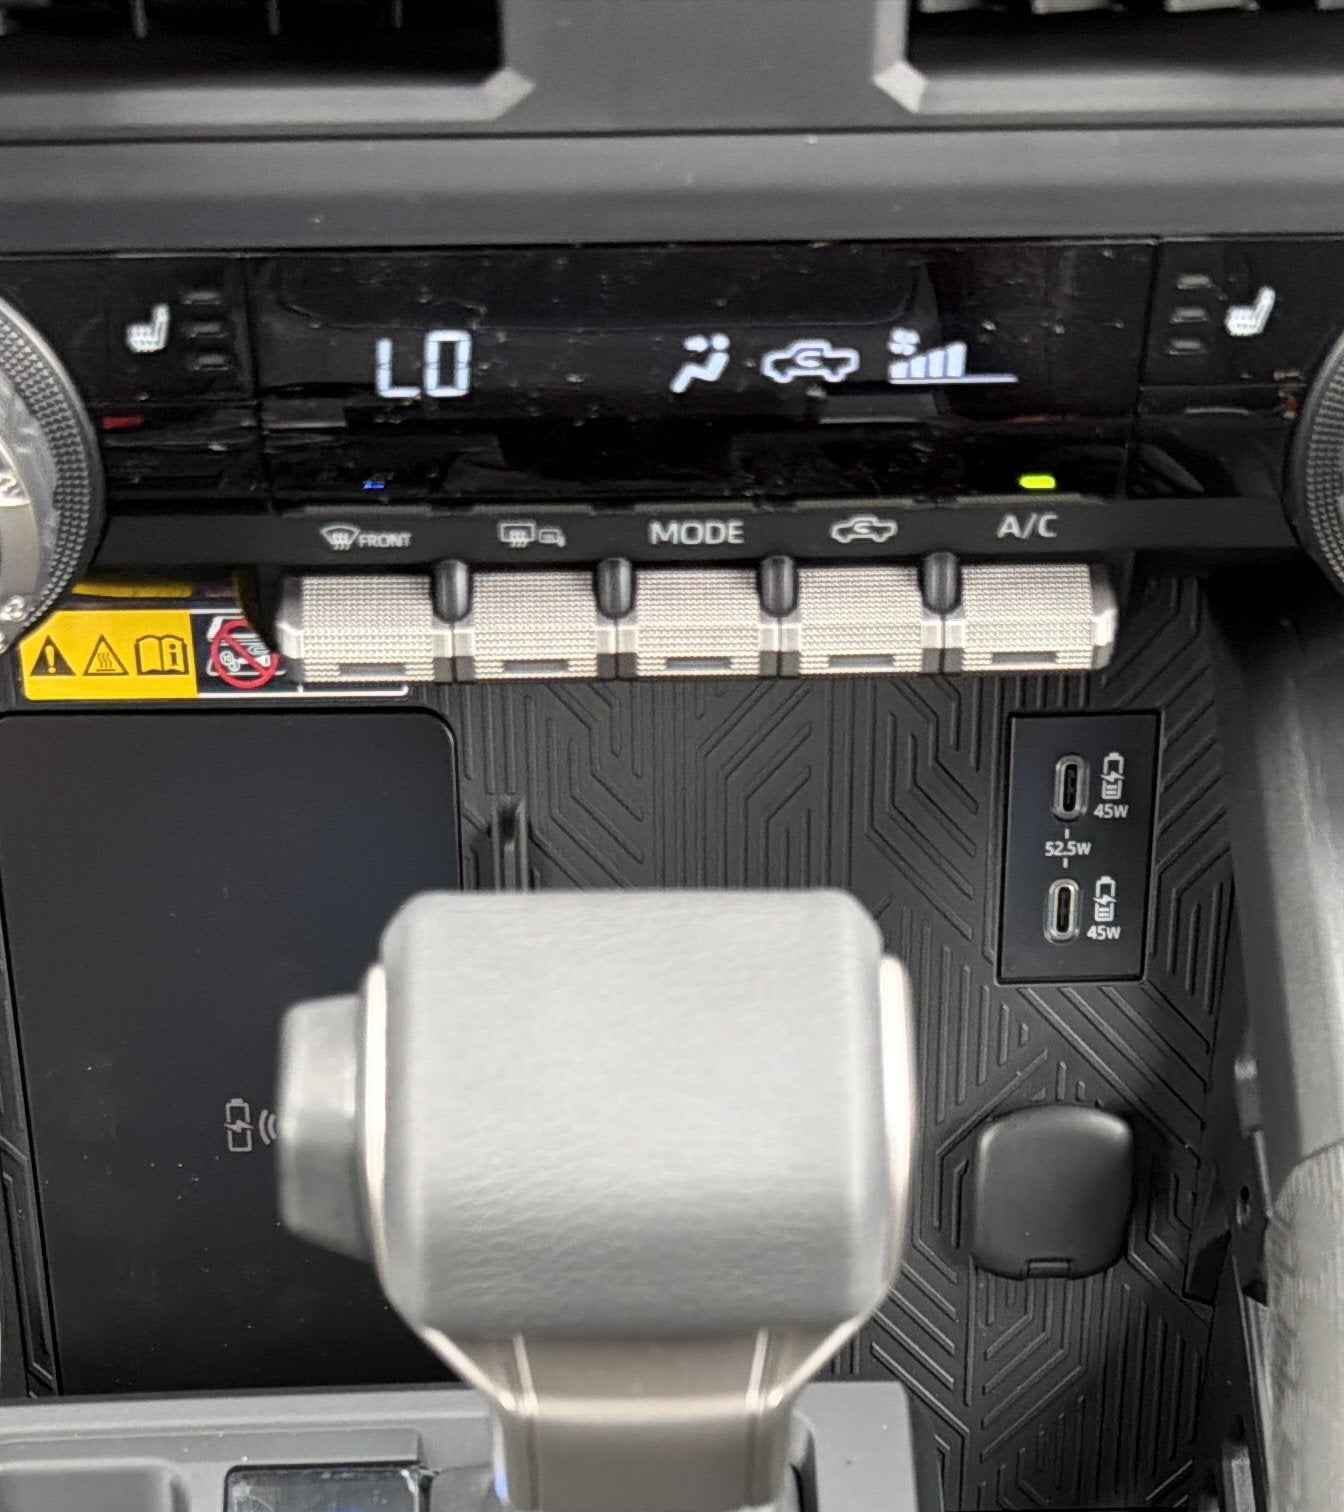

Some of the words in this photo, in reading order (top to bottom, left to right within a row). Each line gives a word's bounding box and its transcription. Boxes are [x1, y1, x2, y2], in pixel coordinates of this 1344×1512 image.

[375, 330, 472, 398] LO
[648, 521, 745, 545] MODE
[997, 514, 1058, 540] A/C
[358, 532, 411, 548] FRONT
[1093, 804, 1129, 819] 45W
[1044, 841, 1092, 857] 52.5W
[1086, 925, 1122, 940] 45W
